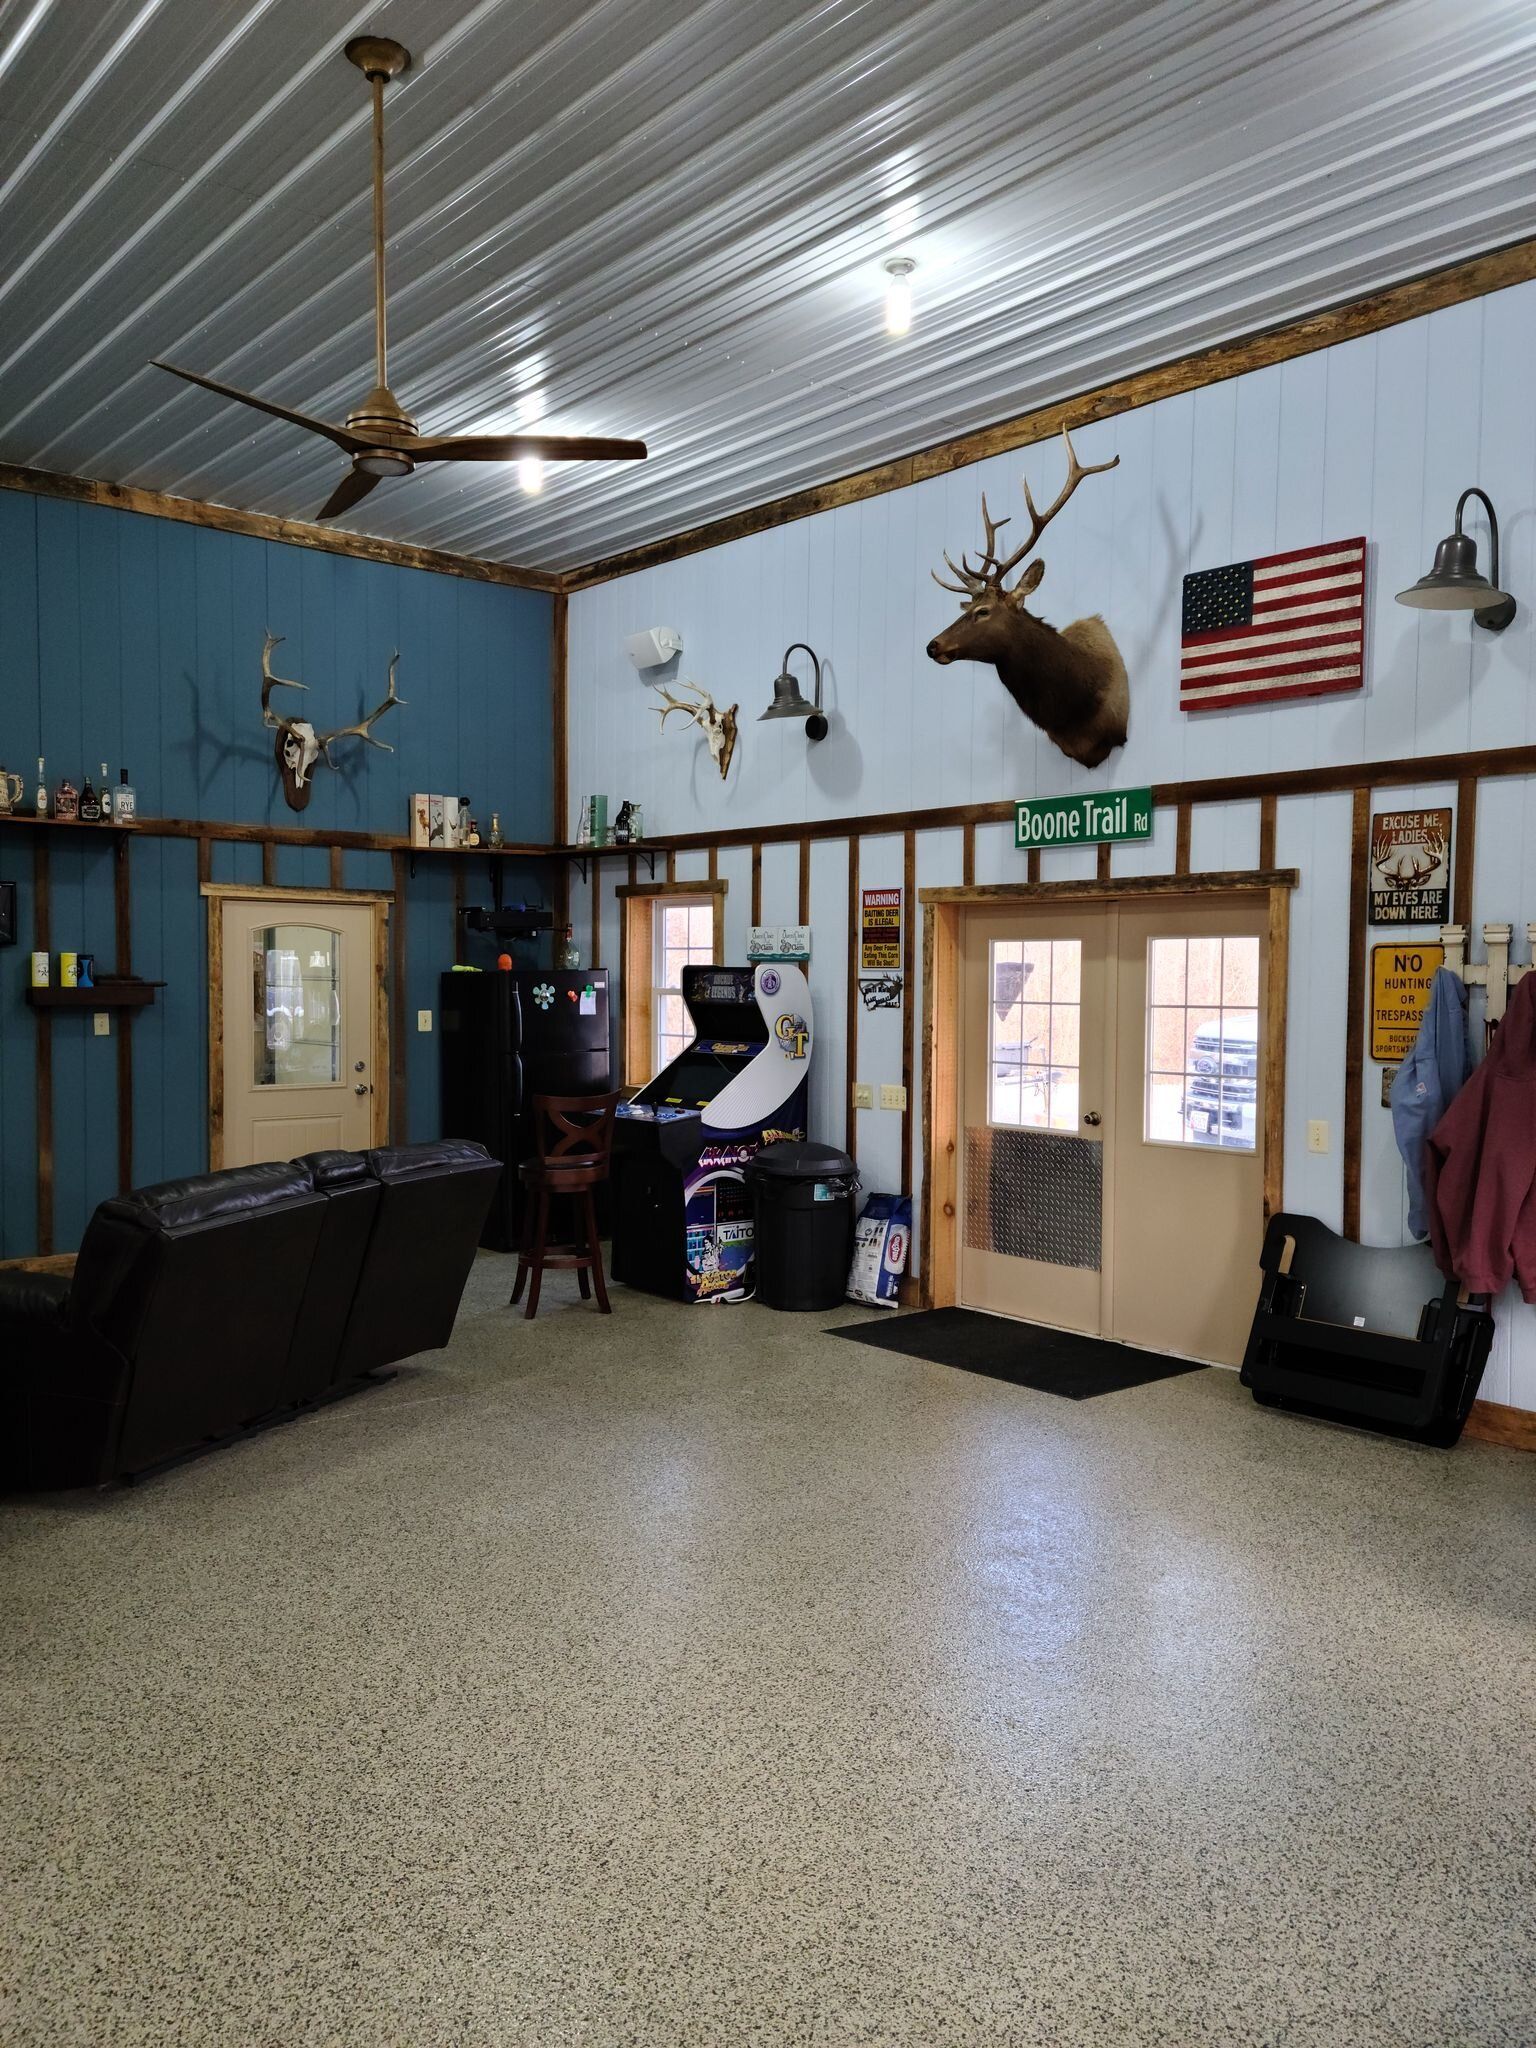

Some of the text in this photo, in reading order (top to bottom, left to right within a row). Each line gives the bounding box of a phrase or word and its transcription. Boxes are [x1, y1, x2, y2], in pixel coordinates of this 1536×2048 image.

[120, 800, 133, 810] RYE
[1018, 797, 1148, 842] Boone Trail Rd
[1382, 815, 1420, 830] EXCUSE
[1392, 829, 1428, 844] LADIES
[864, 894, 900, 906] WARNING
[1374, 890, 1443, 905] MY EYES ARE
[864, 908, 899, 918] BAITING DEER
[1375, 905, 1441, 920] DOWN HERE.
[874, 918, 895, 926] ILLEGAL
[1394, 954, 1423, 973] NO
[1384, 978, 1432, 989] HUNTING
[711, 985, 736, 999] LEGENDS
[1400, 995, 1415, 1005] OR
[723, 1225, 754, 1241] TAITO
